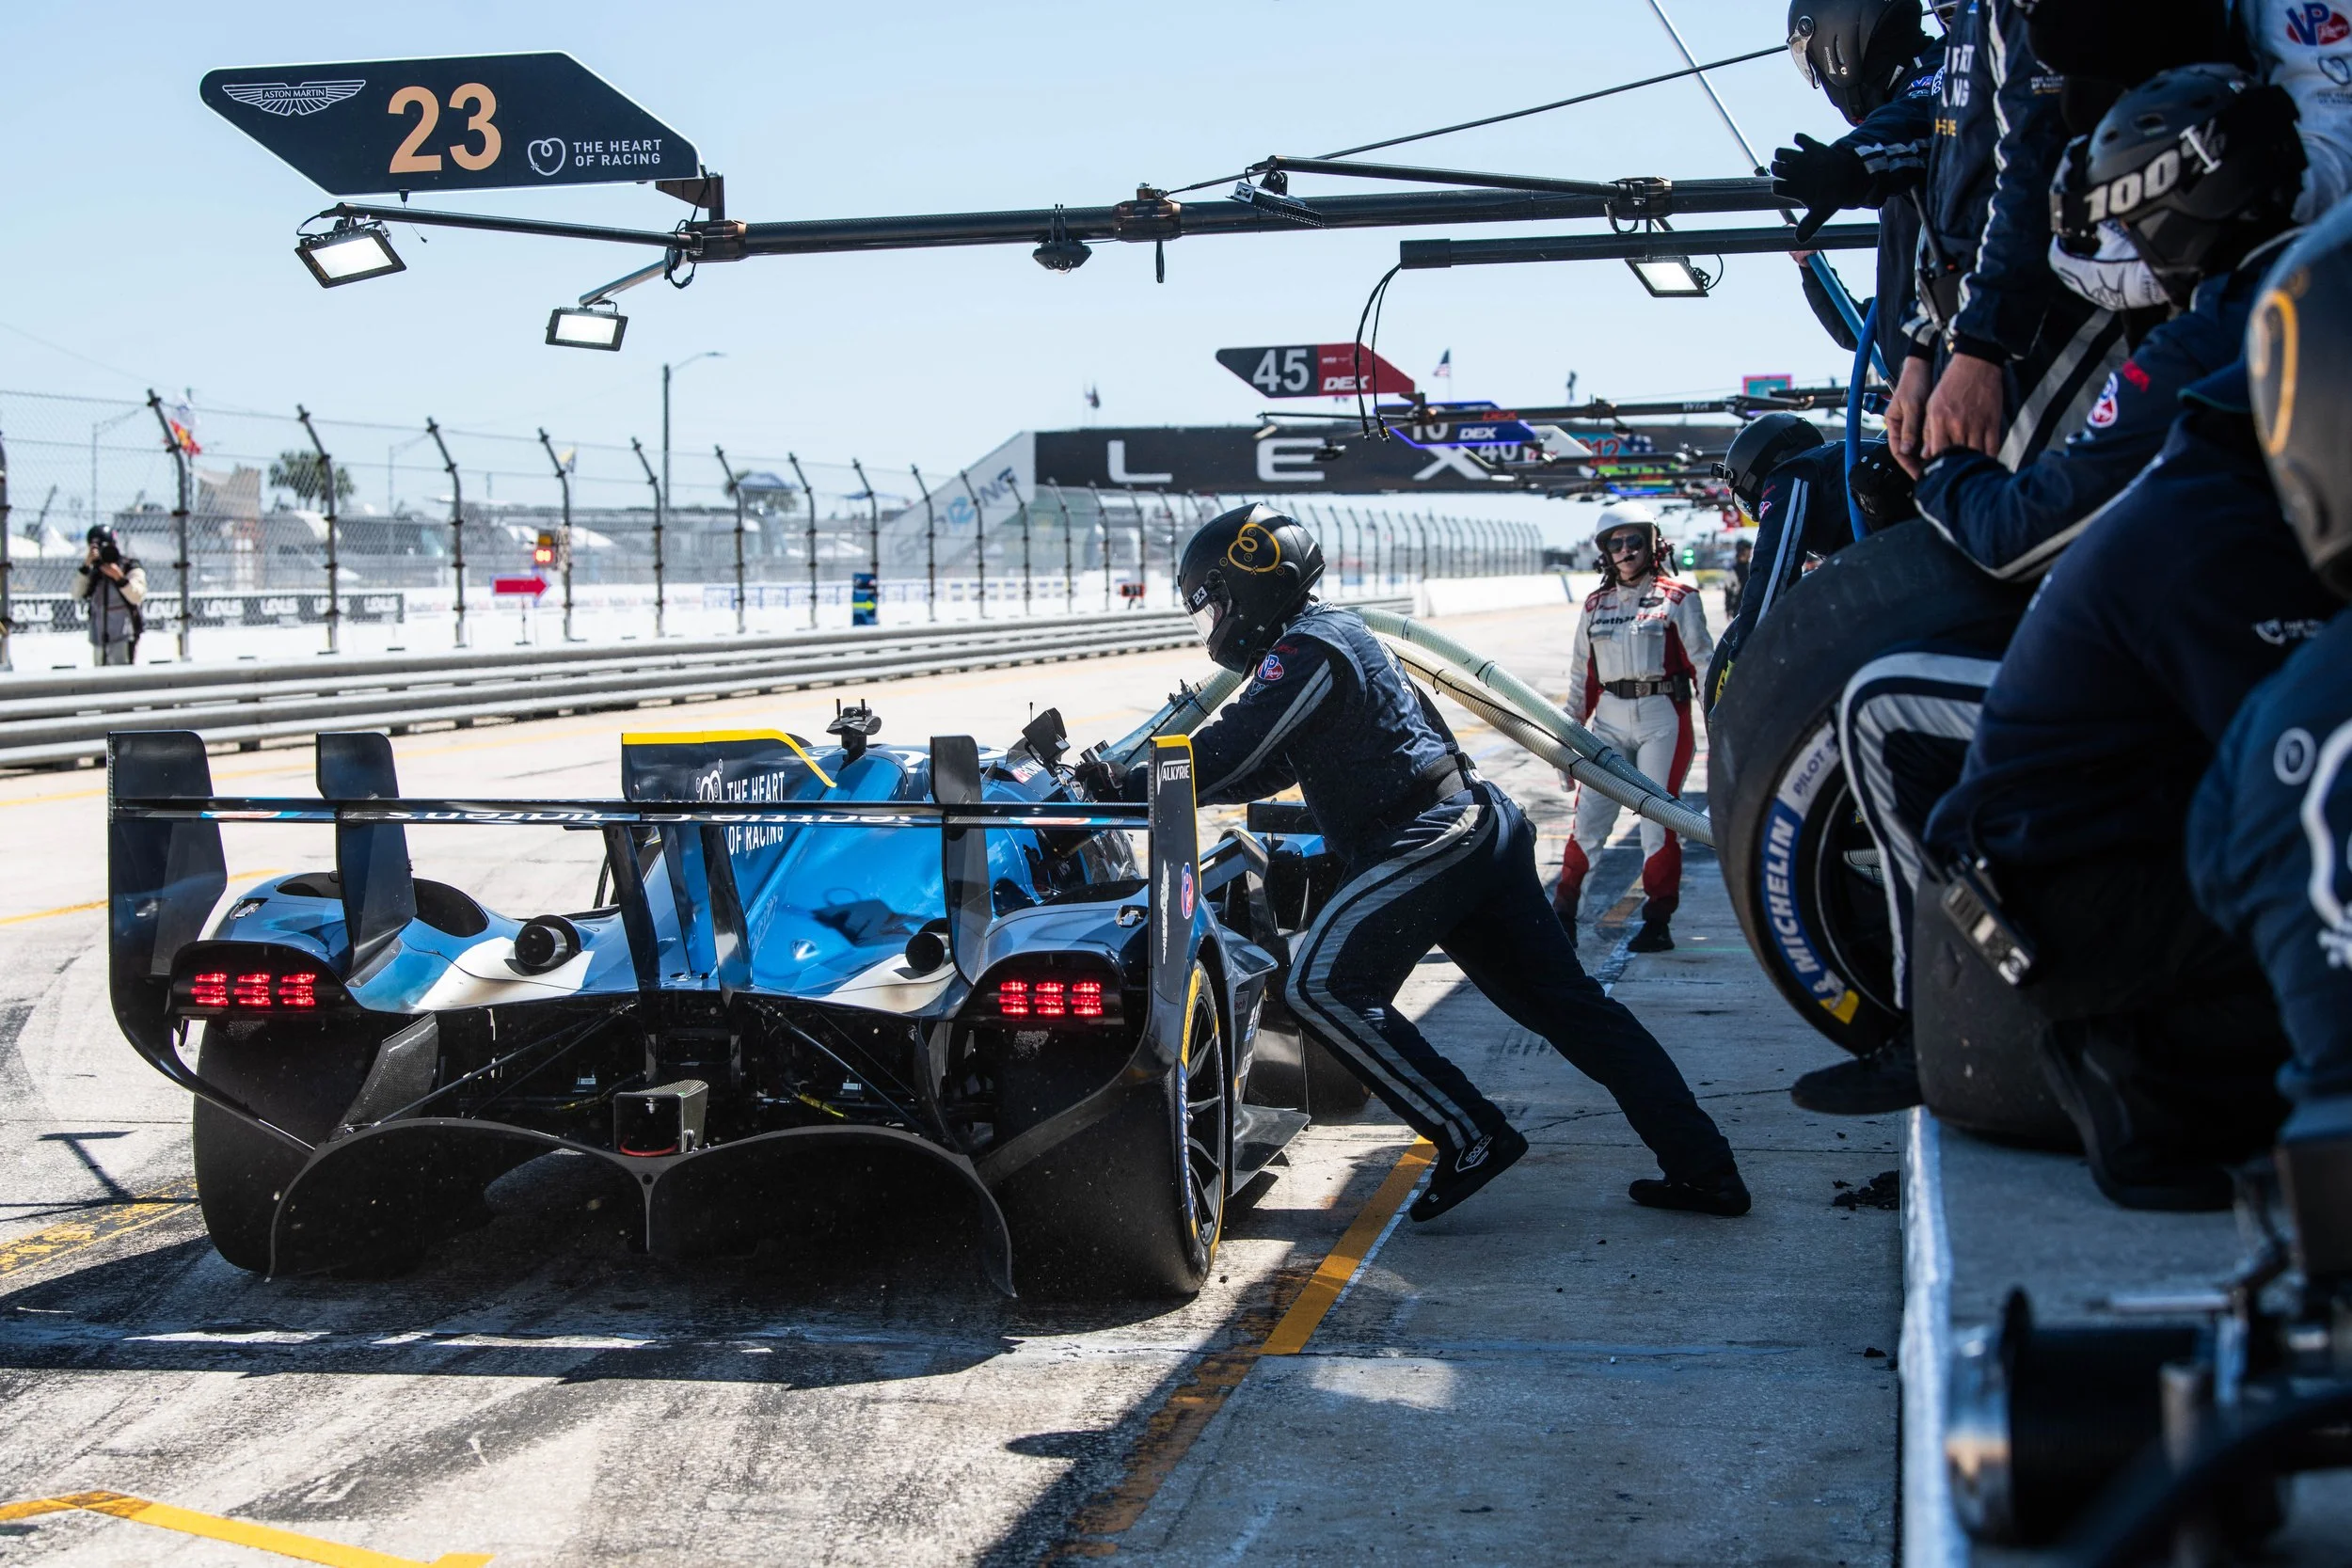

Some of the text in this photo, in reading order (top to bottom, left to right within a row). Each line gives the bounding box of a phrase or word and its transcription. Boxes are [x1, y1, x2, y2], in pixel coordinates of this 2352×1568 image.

[293, 88, 325, 97] MARTIN
[388, 83, 502, 173] 23
[573, 139, 662, 153] THE HEART
[575, 152, 661, 167] OF RACING
[1252, 349, 1311, 392] 45
[1459, 428, 1497, 440] DEX
[1477, 444, 1519, 463] 40
[1192, 585, 1209, 607] 23
[727, 771, 786, 801] THE HEART
[1156, 758, 1191, 796] VALKYRIE
[1793, 752, 1825, 798] PILOT
[728, 825, 785, 856] OF RACING
[1766, 816, 1820, 974] MICHELIN
